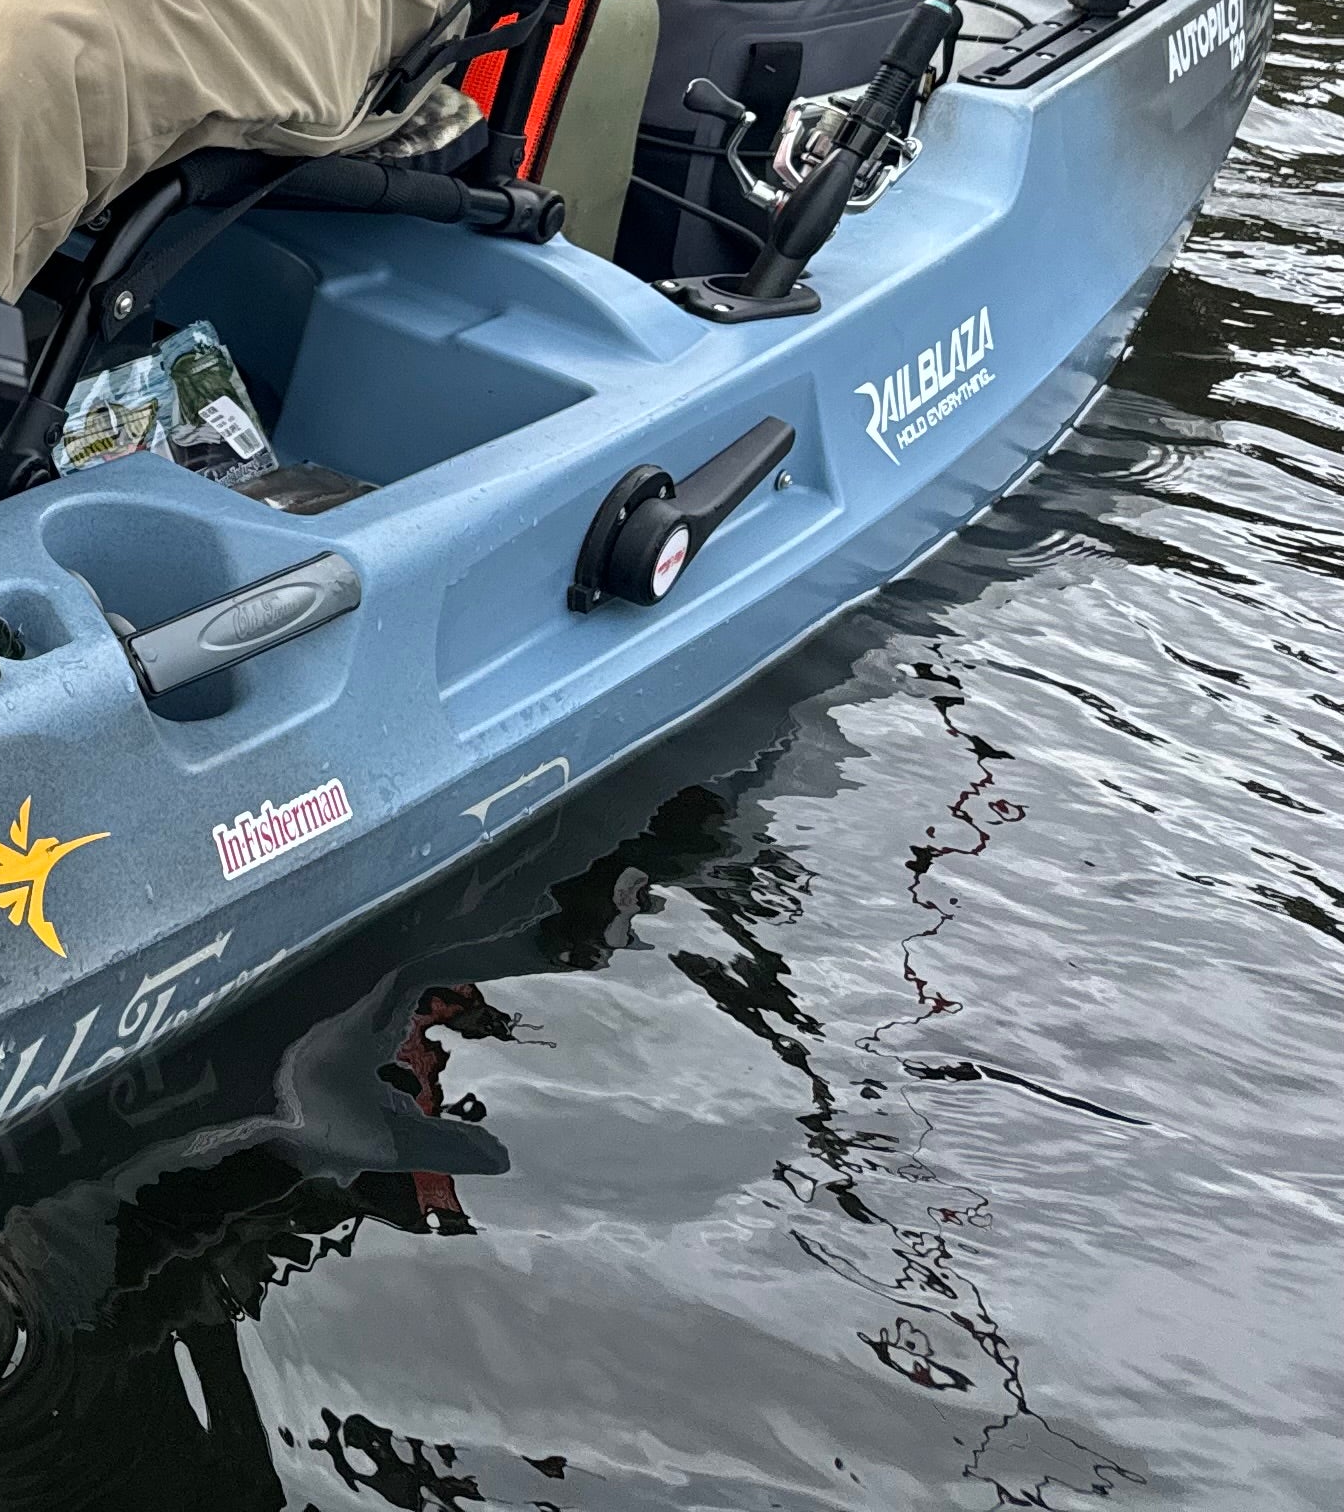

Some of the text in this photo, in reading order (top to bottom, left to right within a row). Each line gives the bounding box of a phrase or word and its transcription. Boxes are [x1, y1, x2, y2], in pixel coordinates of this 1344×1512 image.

[1229, 29, 1246, 70] 120
[853, 306, 994, 466] RAILBLAZA
[895, 416, 928, 450] HOLD
